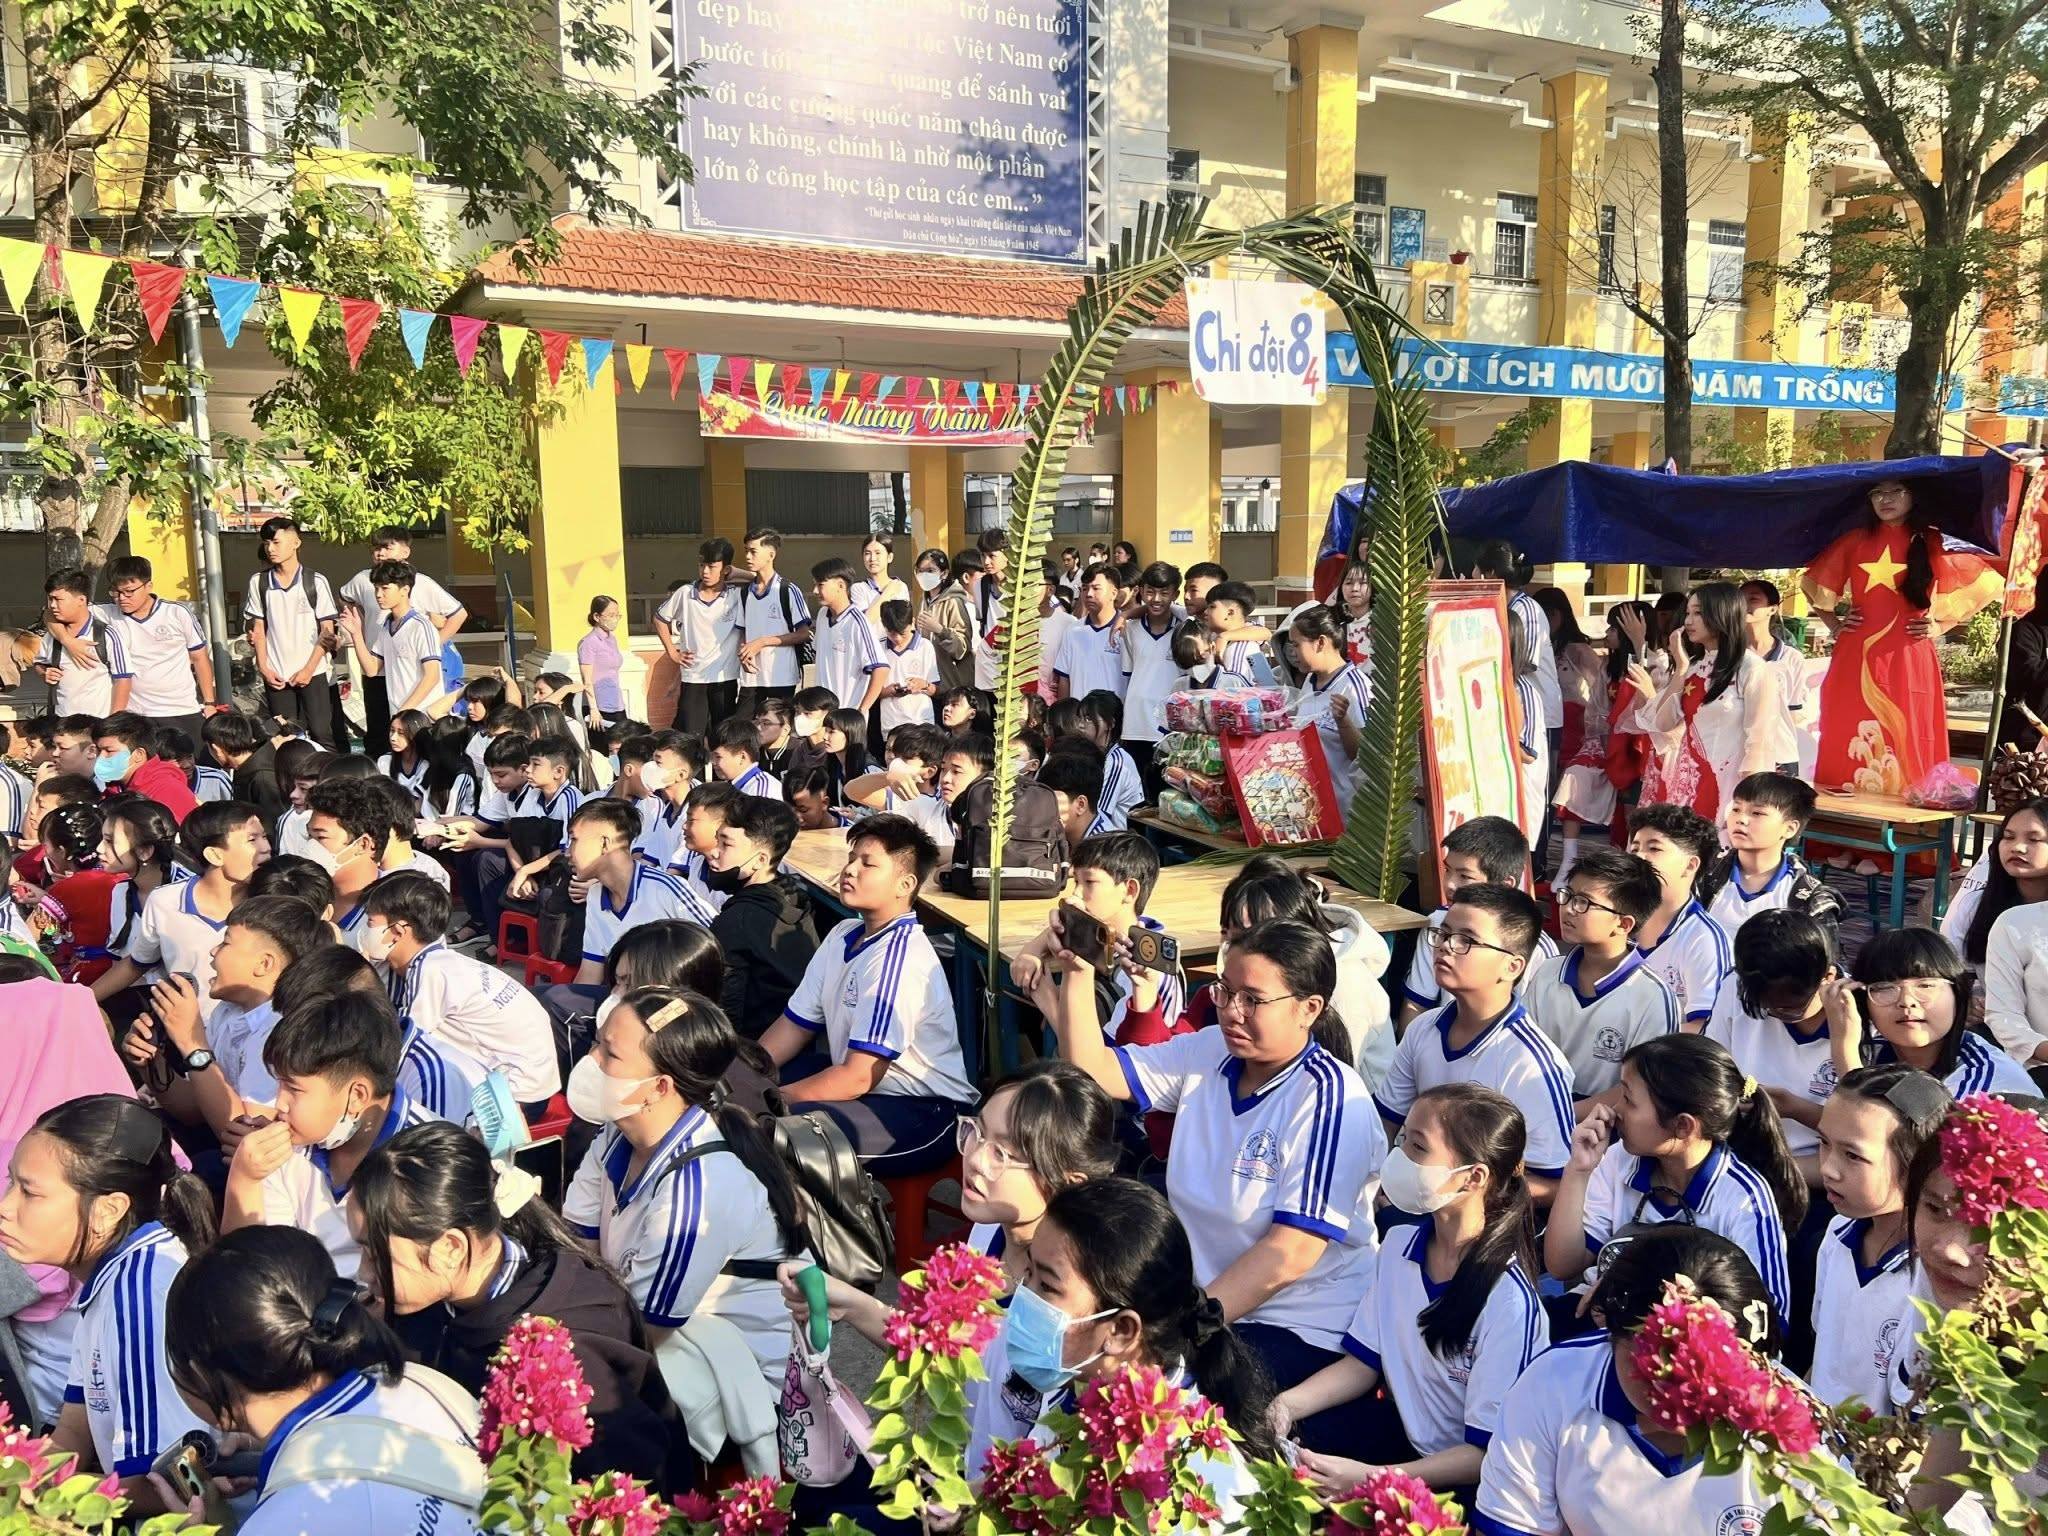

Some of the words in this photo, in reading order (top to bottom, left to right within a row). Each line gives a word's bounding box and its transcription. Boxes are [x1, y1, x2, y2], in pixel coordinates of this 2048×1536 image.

[746, 3, 785, 33] hay
[952, 36, 994, 64] Việt
[999, 43, 1043, 69] Nam
[1048, 52, 1069, 73] có
[995, 7, 1030, 30] nên
[1036, 15, 1071, 36] tươi
[699, 36, 754, 66] bước
[958, 72, 983, 98] để
[988, 81, 1033, 106] sánh
[1039, 89, 1067, 110] vai
[703, 116, 742, 148] hay
[749, 122, 822, 157] không,
[828, 133, 883, 159] chính
[889, 140, 907, 163] là
[913, 145, 951, 168] nhờ
[956, 150, 994, 175] một
[999, 152, 1045, 180] phần
[744, 87, 782, 111] các
[862, 103, 912, 128] quốc
[918, 112, 962, 134] năm
[968, 116, 1017, 141] châu
[1021, 122, 1068, 150] được
[703, 156, 740, 181] lớn
[745, 158, 759, 184] ở
[766, 165, 817, 196] công
[823, 170, 860, 198] học
[866, 176, 900, 204] tập
[905, 178, 940, 203] của
[946, 184, 978, 206] các
[1195, 310, 1240, 373] Chi
[1248, 319, 1285, 379] đội
[1287, 312, 1312, 376] 8
[1302, 356, 1319, 397] 4
[1487, 352, 1555, 388] ÍCH
[1692, 369, 1762, 400] NĂM
